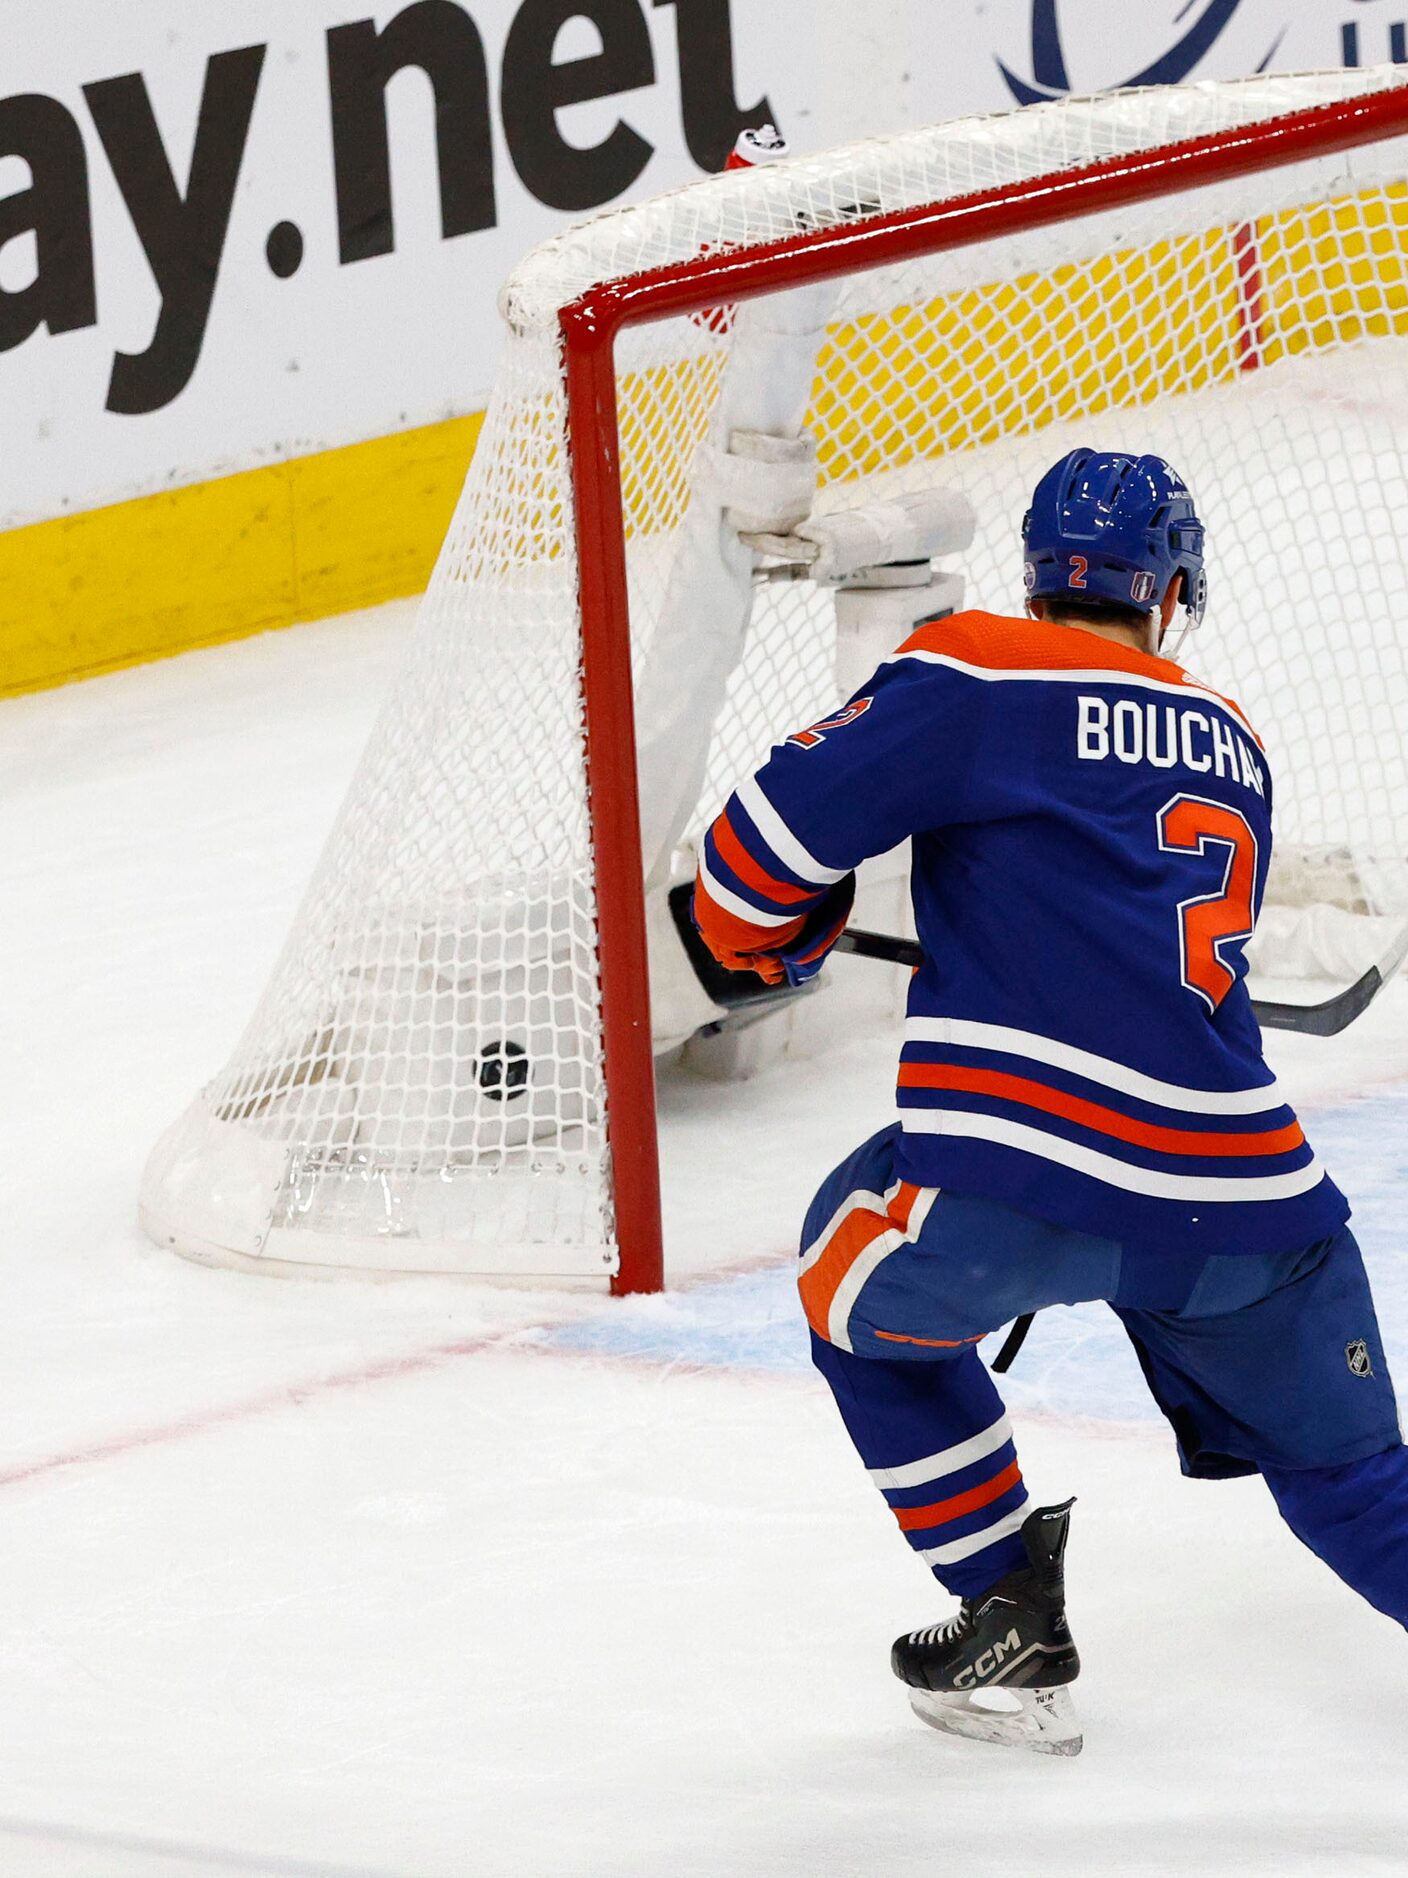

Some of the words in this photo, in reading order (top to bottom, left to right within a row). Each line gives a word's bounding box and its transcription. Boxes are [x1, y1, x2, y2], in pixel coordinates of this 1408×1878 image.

[1069, 556, 1087, 588] 2
[1077, 696, 1264, 797] BOUCHA
[1156, 792, 1258, 1015] 2
[953, 1628, 1021, 1689] CCM
